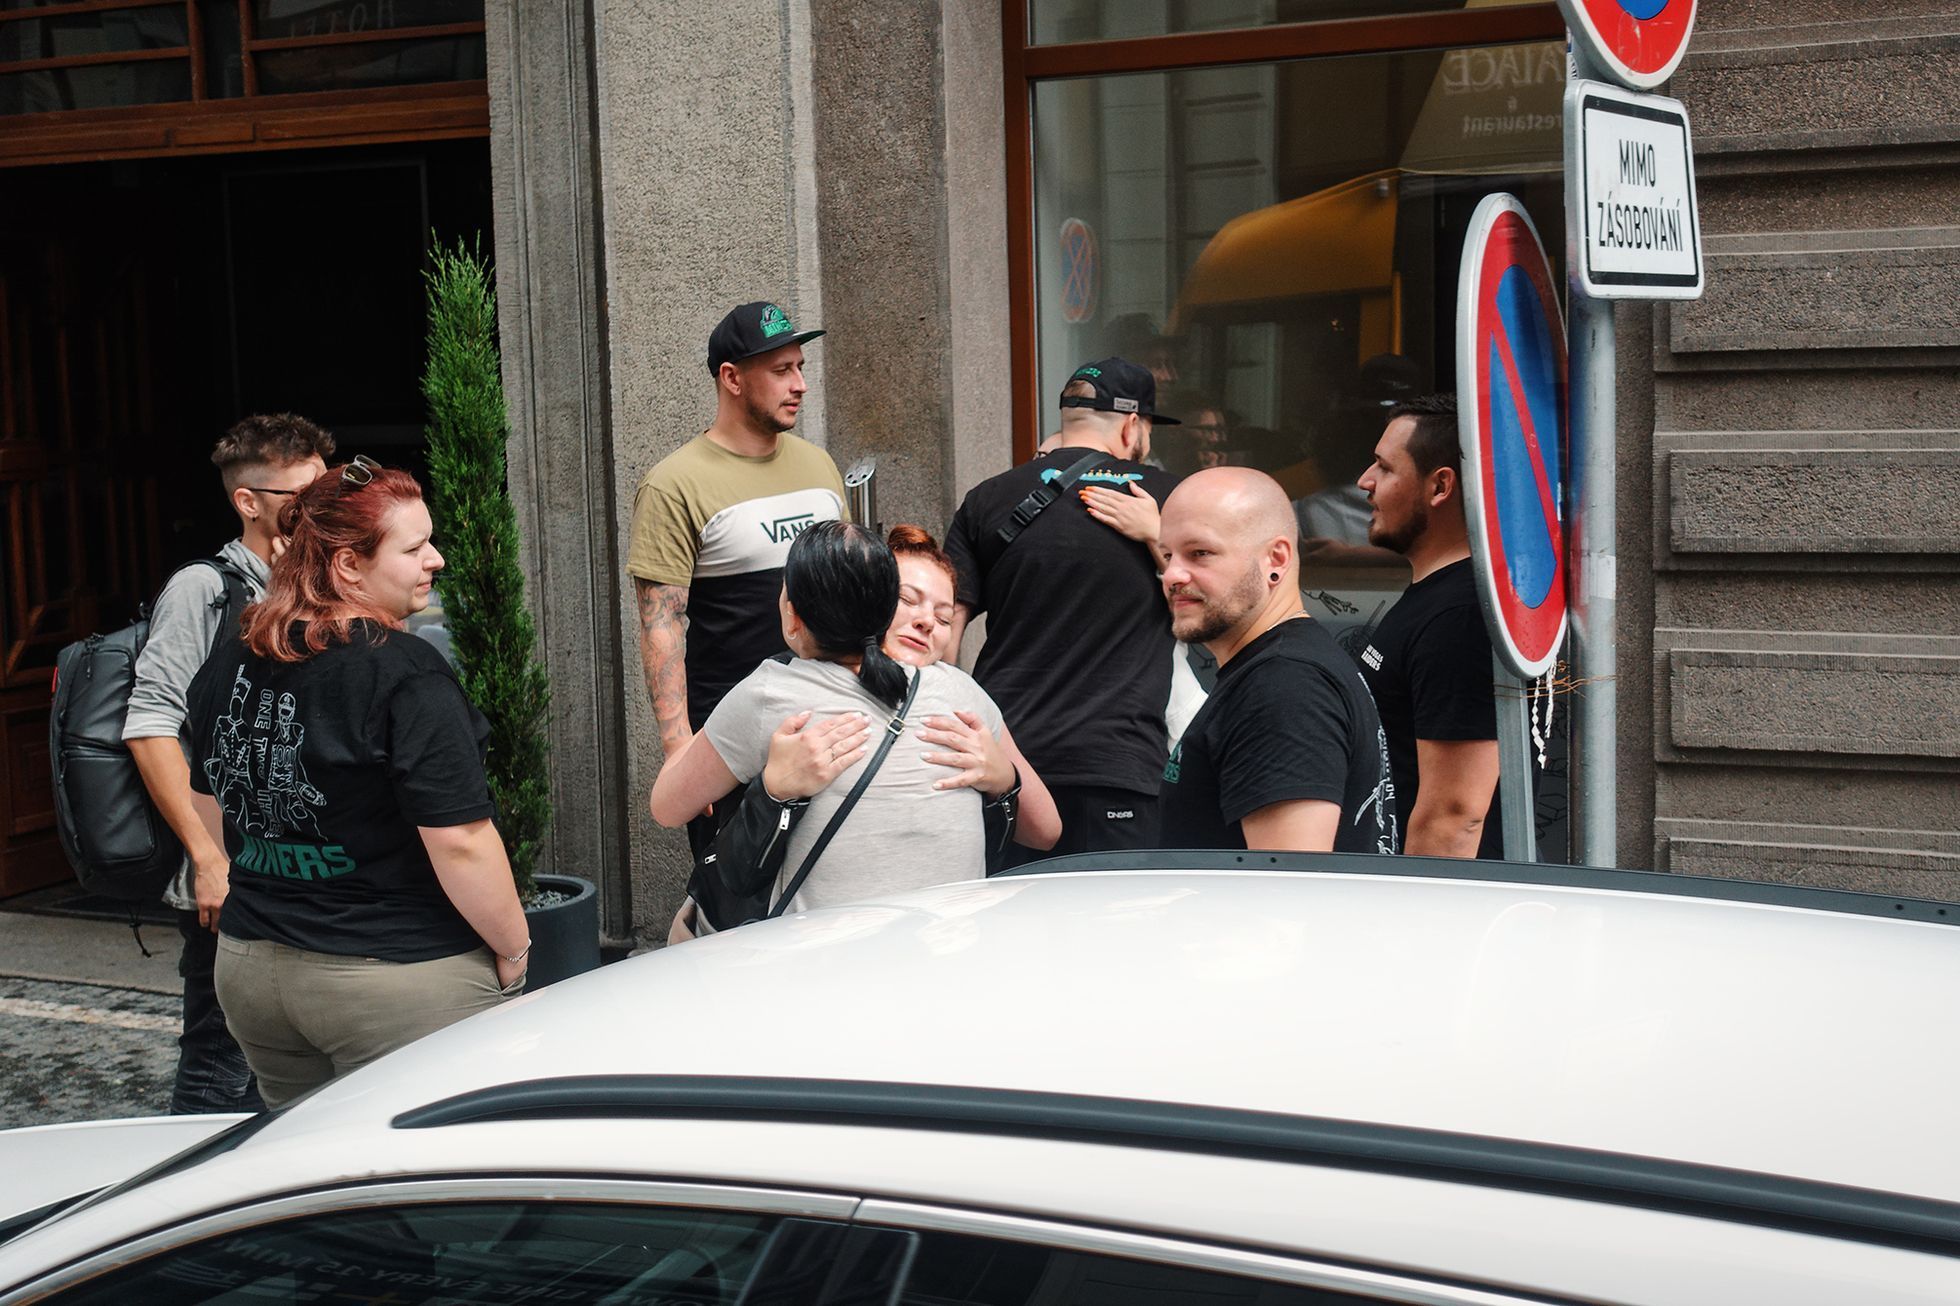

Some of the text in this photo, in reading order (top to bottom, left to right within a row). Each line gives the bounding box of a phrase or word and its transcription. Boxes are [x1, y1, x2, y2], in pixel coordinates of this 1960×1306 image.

[1619, 139, 1656, 188] MIMO
[1597, 190, 1683, 252] ZÁSOBOVÁNÍ
[254, 688, 275, 730] ONE
[234, 832, 357, 881] MINERS
